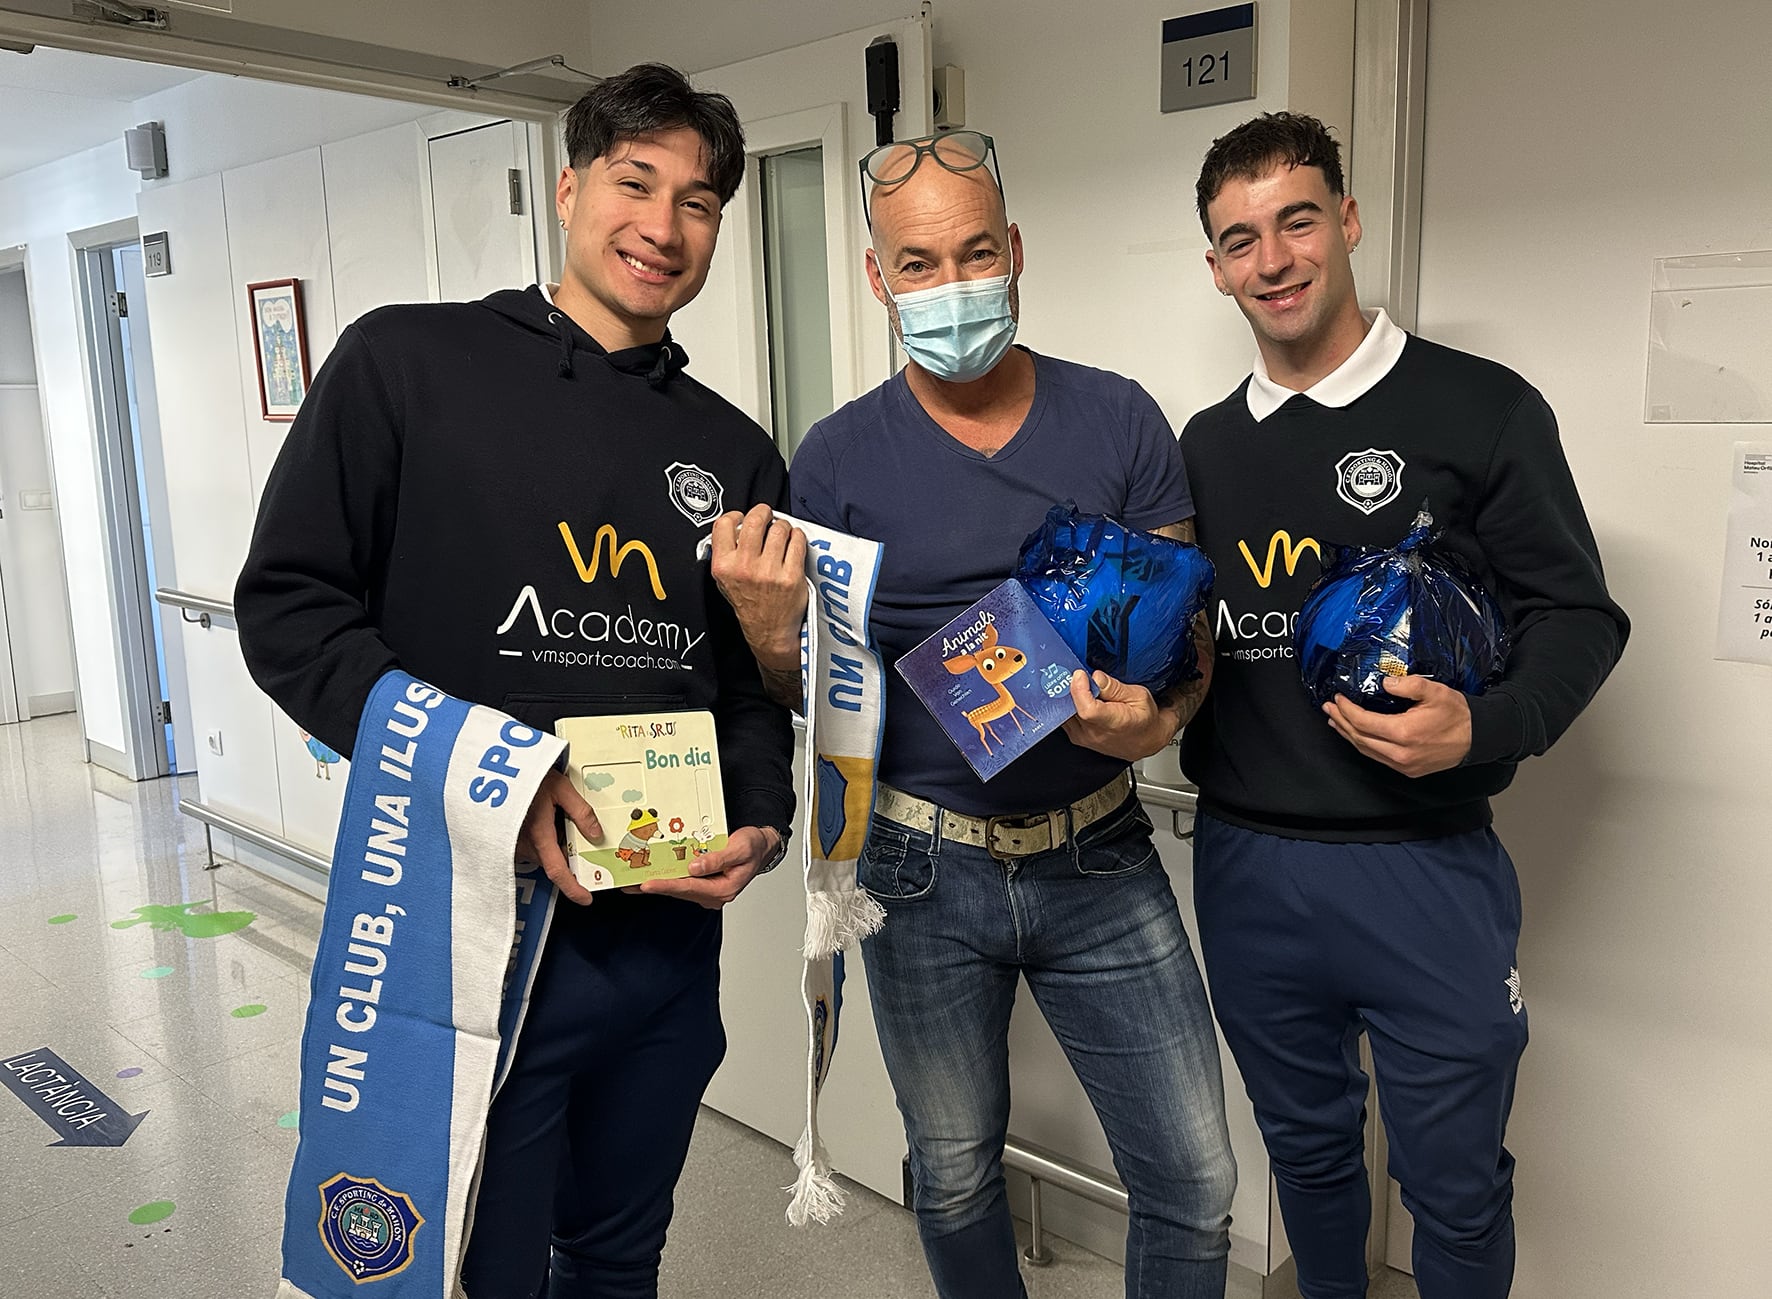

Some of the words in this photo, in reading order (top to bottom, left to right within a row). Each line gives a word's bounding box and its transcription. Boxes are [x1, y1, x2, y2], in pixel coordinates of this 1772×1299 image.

[1182, 50, 1229, 88] 121
[148, 251, 162, 268] 119
[1756, 551, 1763, 562] 1
[496, 585, 706, 660] Academy
[1753, 612, 1761, 623] 1
[942, 610, 996, 658] Animals
[964, 643, 976, 652] la
[974, 632, 989, 646] nit
[531, 649, 682, 670] vmsportcoach.com
[1047, 674, 1073, 698] sons
[380, 681, 447, 782] ILUS
[469, 720, 543, 808] SPO
[645, 749, 680, 770] Bon
[684, 747, 712, 767] dia
[361, 794, 411, 886] UNA
[335, 903, 407, 1033] CLUB,
[321, 1044, 368, 1113] UN
[339, 1189, 378, 1206] SPORTING
